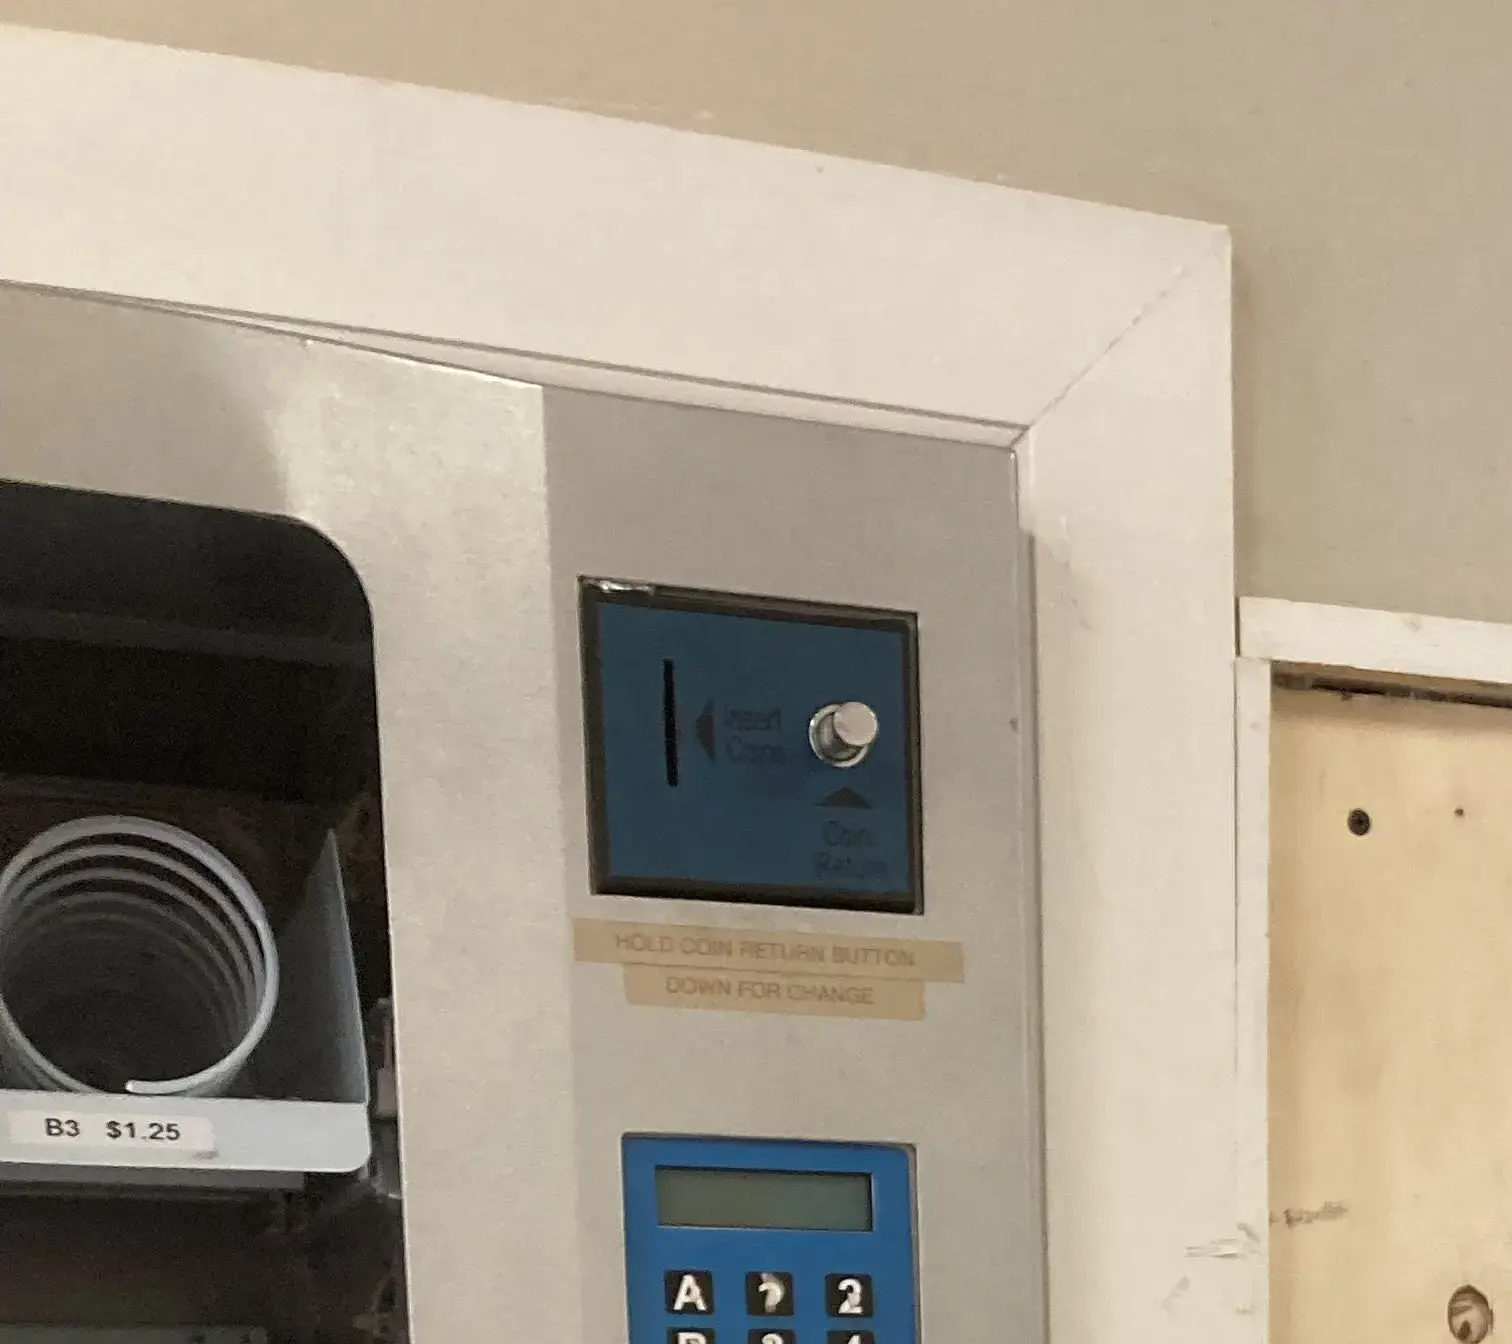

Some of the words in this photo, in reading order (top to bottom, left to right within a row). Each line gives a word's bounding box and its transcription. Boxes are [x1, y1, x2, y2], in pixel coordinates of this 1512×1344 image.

[613, 932, 672, 953] HOLD
[679, 936, 733, 957] COIN
[740, 940, 828, 965] RETURN
[831, 942, 916, 967] BUTTON
[665, 975, 731, 996] DOWN
[738, 980, 781, 1000] FOR
[786, 983, 877, 1006] CHANGE
[44, 1117, 81, 1138] B3
[106, 1120, 182, 1142] $1.25
[673, 1273, 709, 1311] A
[837, 1277, 864, 1315] 2
